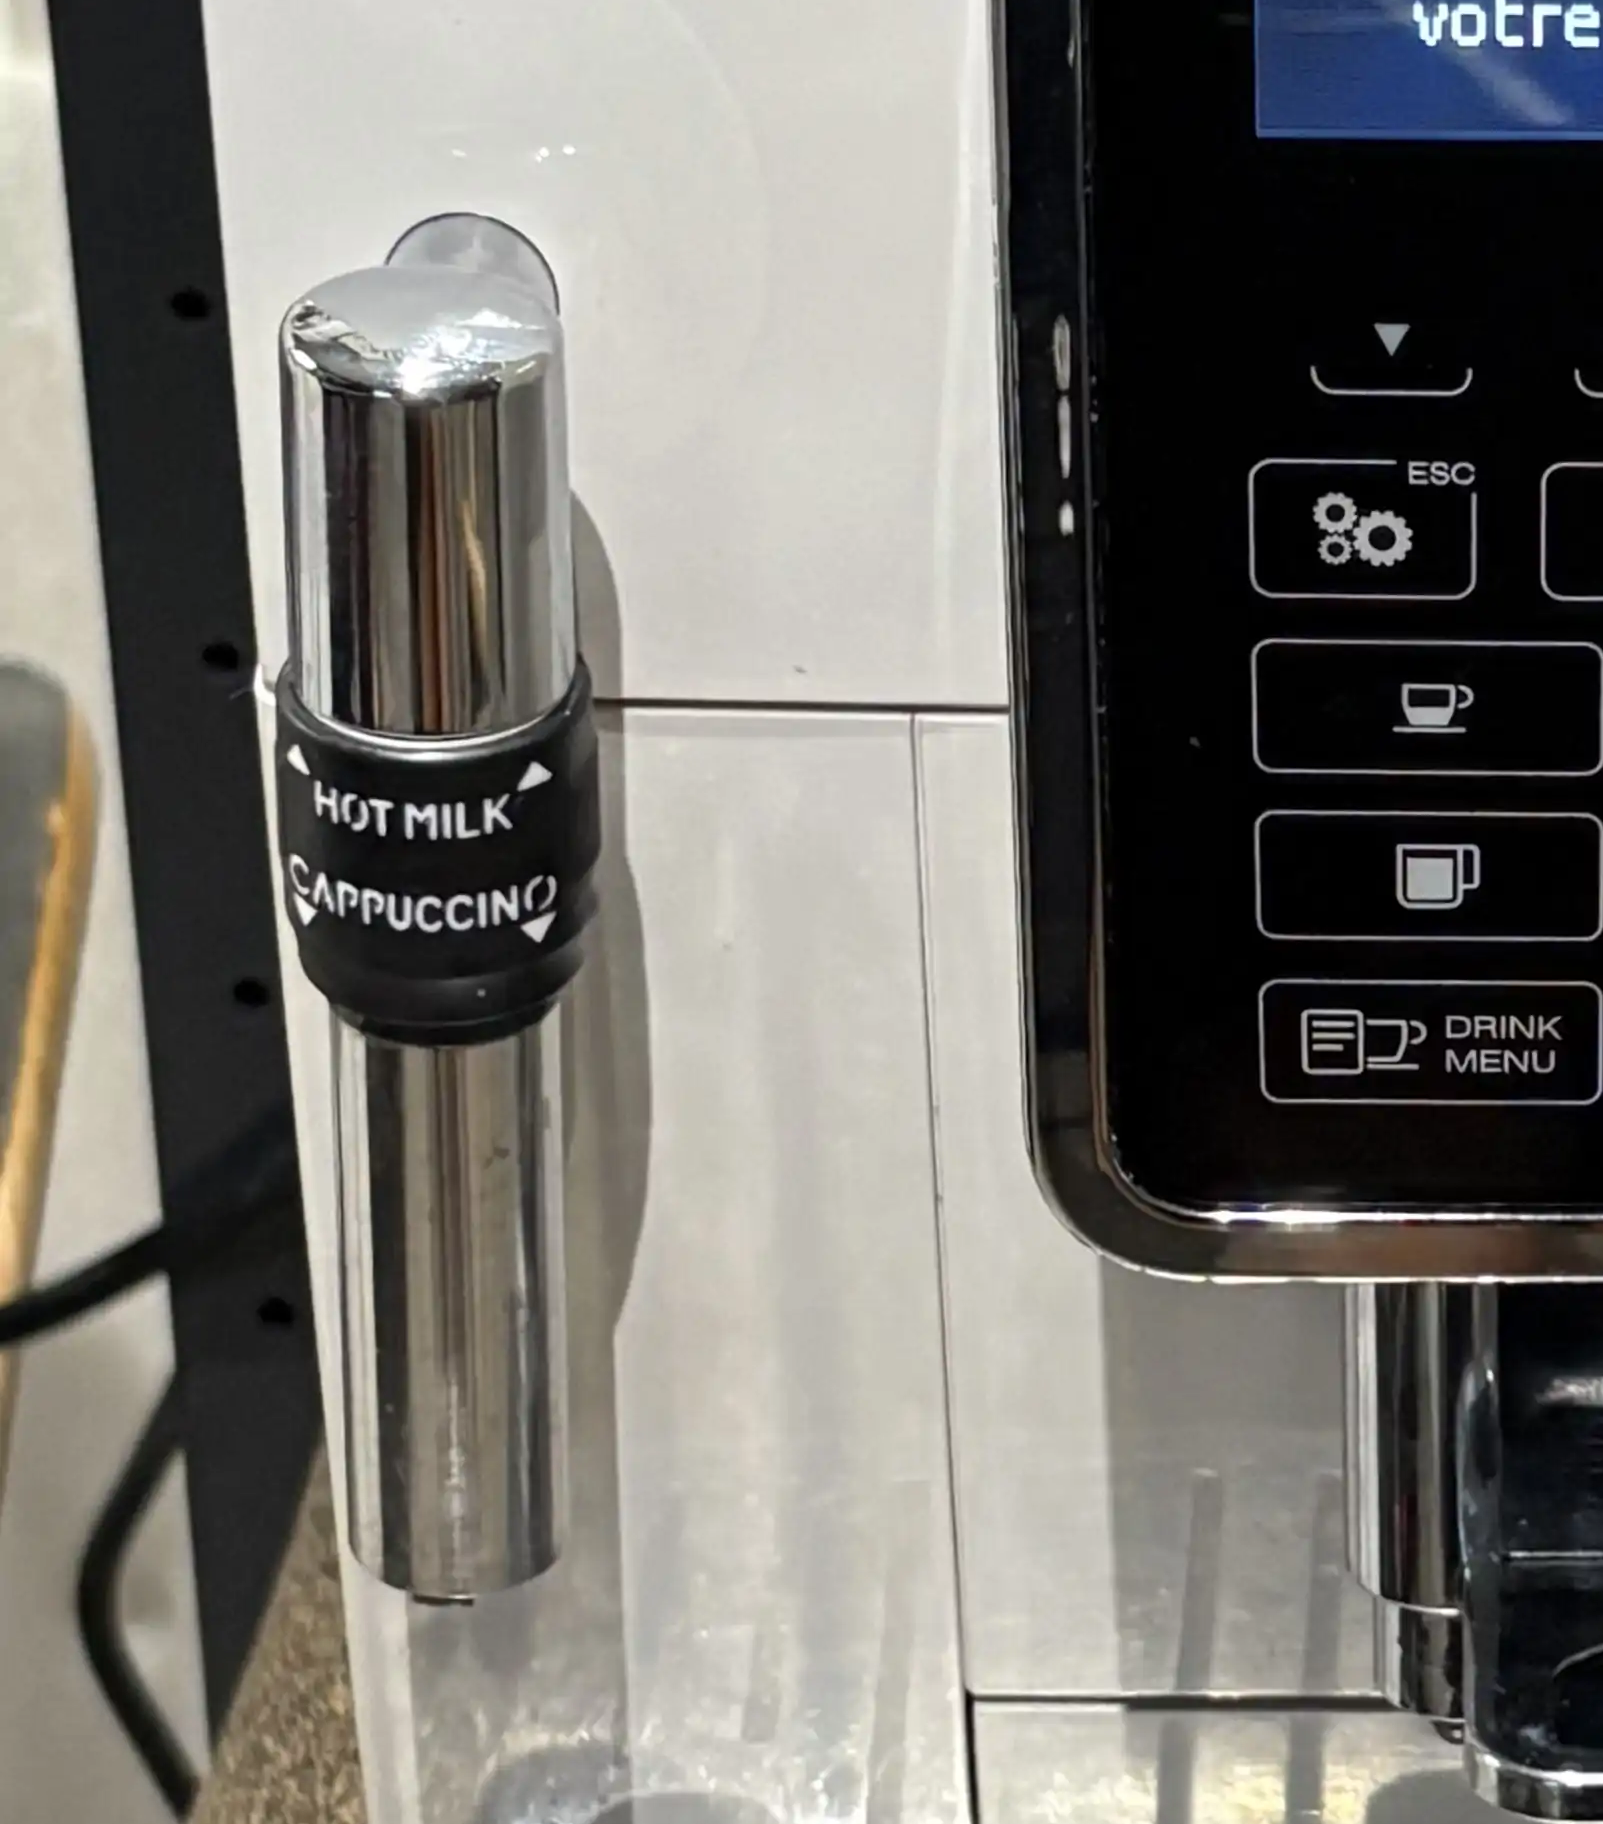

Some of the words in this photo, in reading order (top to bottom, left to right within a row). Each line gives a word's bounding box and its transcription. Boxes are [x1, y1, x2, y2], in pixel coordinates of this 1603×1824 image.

[1407, 461, 1476, 486] ESC
[313, 779, 394, 837] HOT
[404, 793, 514, 841] MILK
[288, 853, 558, 933] CAPPUCCINO
[1445, 1014, 1563, 1040] DRINK
[1445, 1048, 1557, 1074] MENU
